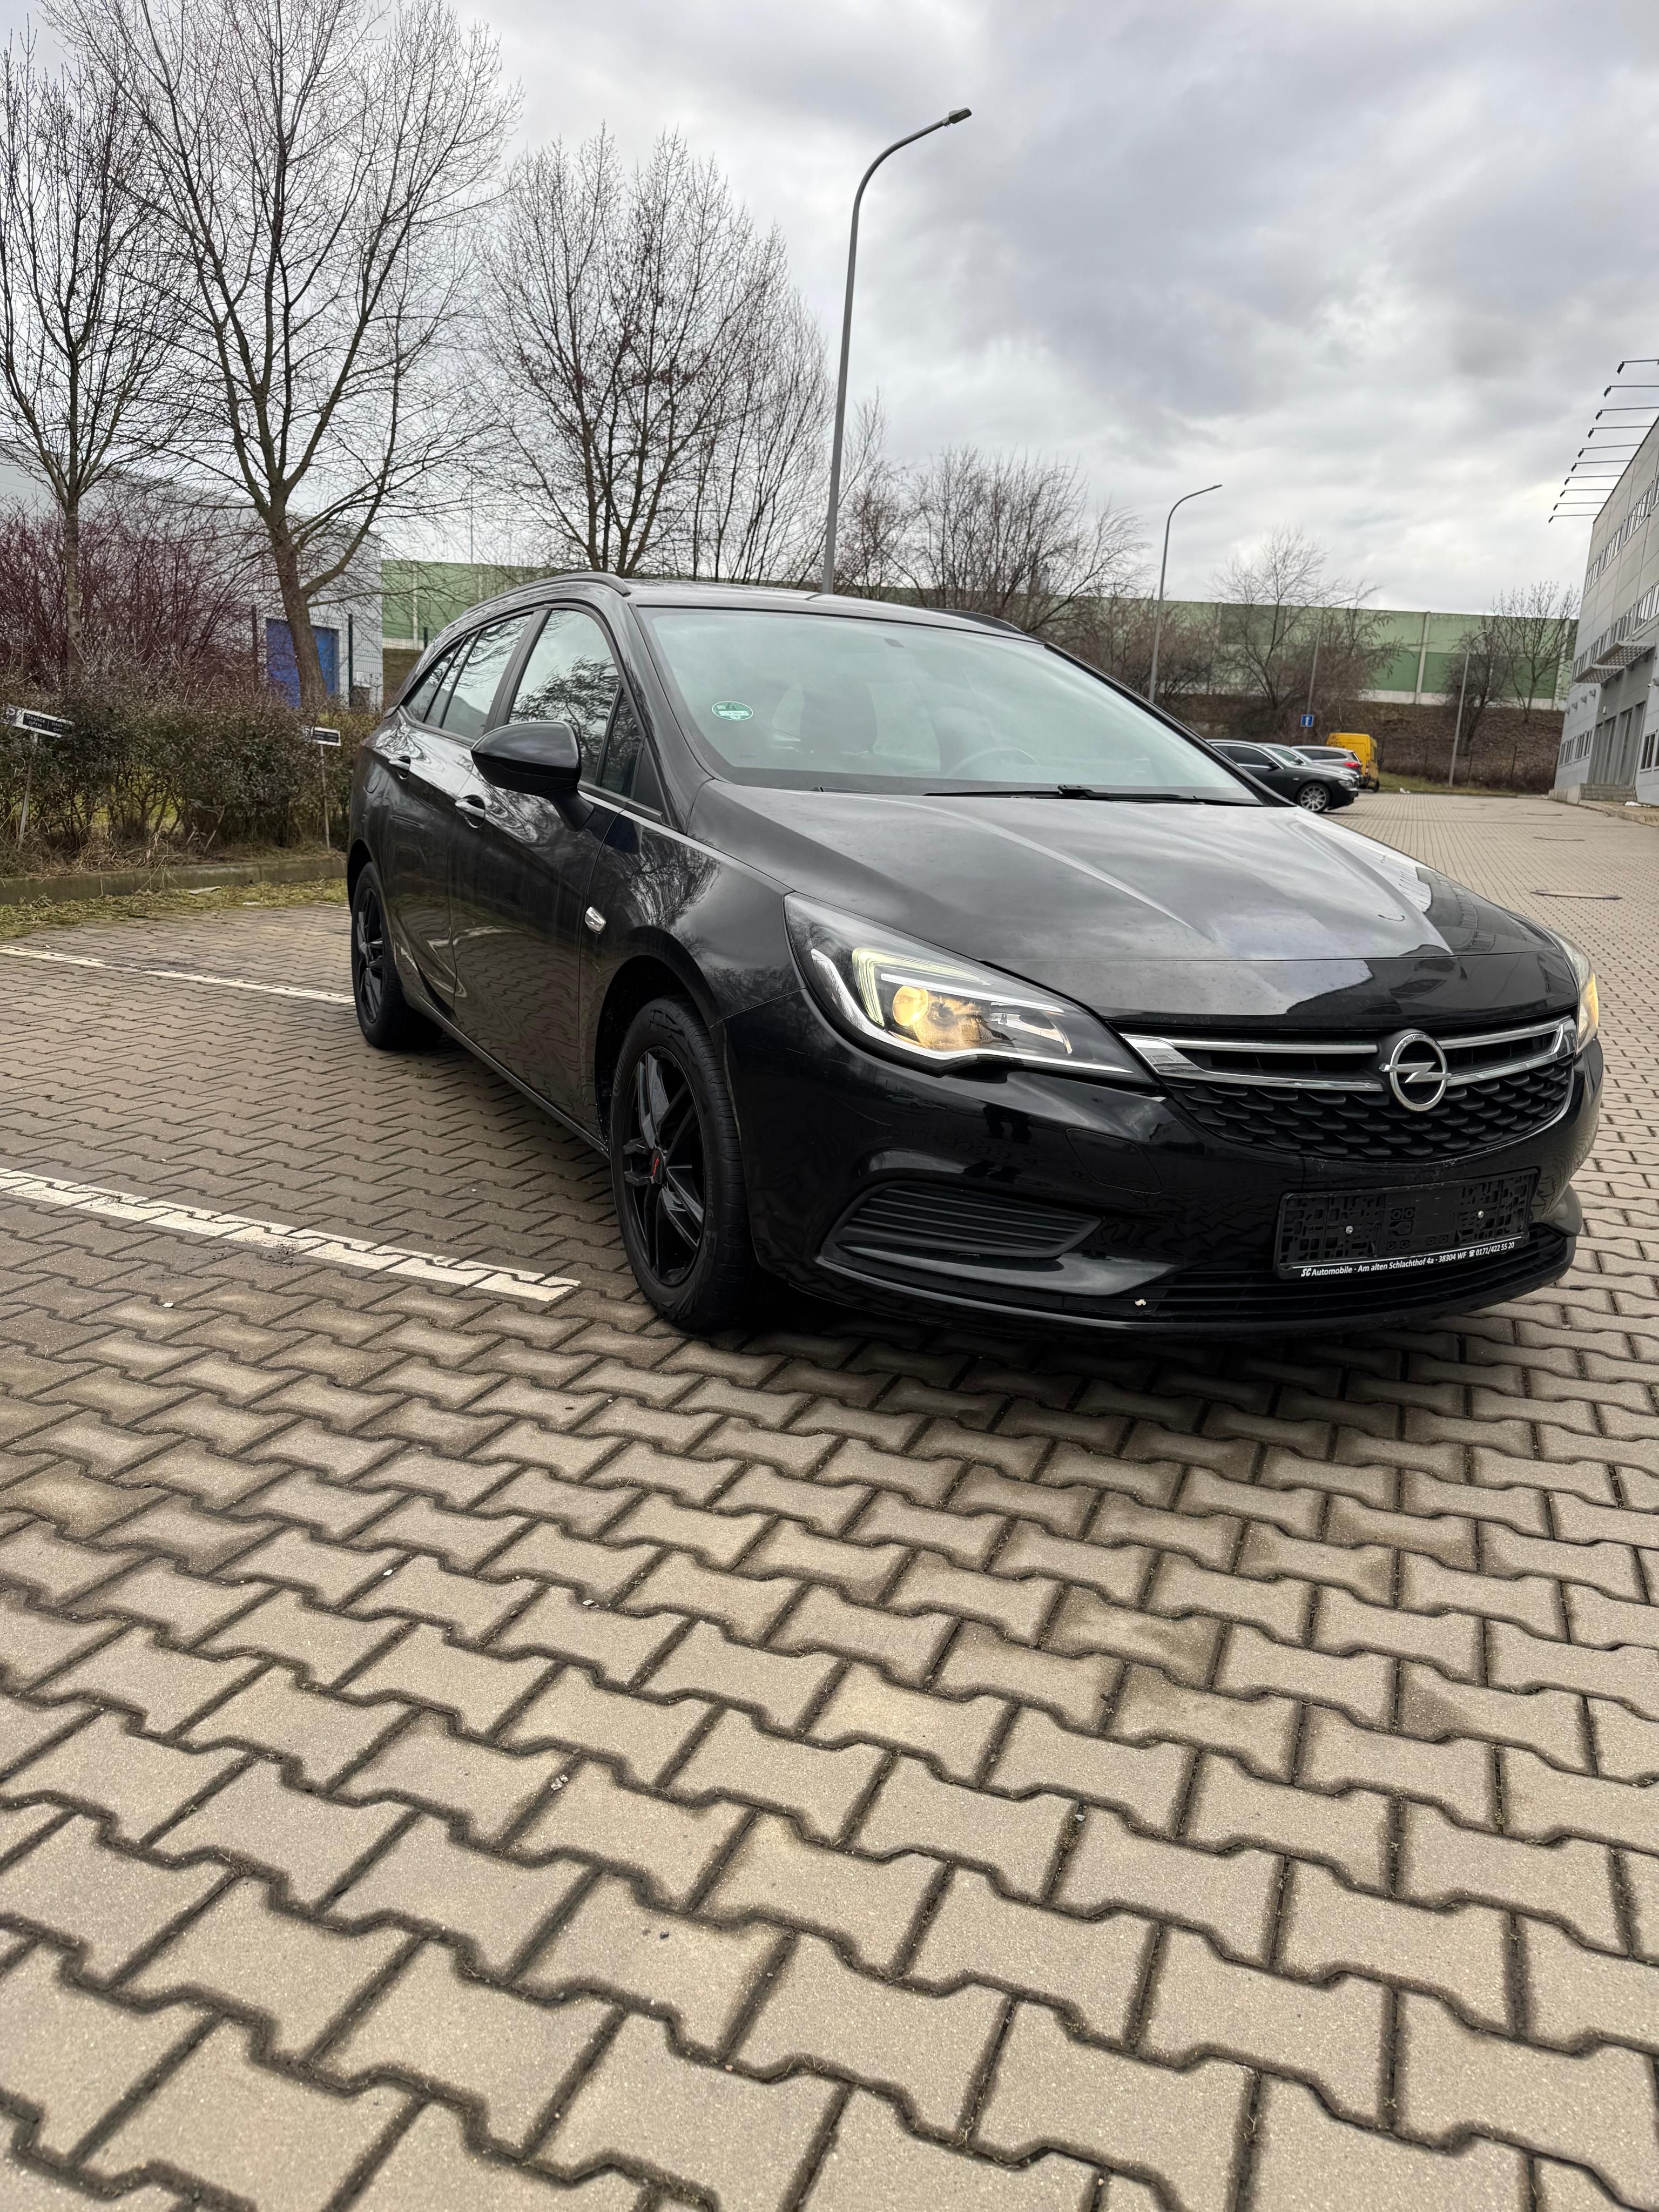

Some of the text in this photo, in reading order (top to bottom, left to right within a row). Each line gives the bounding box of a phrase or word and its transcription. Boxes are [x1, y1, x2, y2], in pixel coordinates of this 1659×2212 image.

[1301, 1268, 1311, 1277] SC
[1311, 1266, 1352, 1277] Automobile
[1371, 1263, 1387, 1271] alten
[1389, 1257, 1426, 1269] Schlachthof
[1439, 1253, 1456, 1263] 38304
[1457, 1251, 1467, 1259] WF
[1476, 1245, 1500, 1256] 0171/422
[1508, 1241, 1515, 1249] 20
